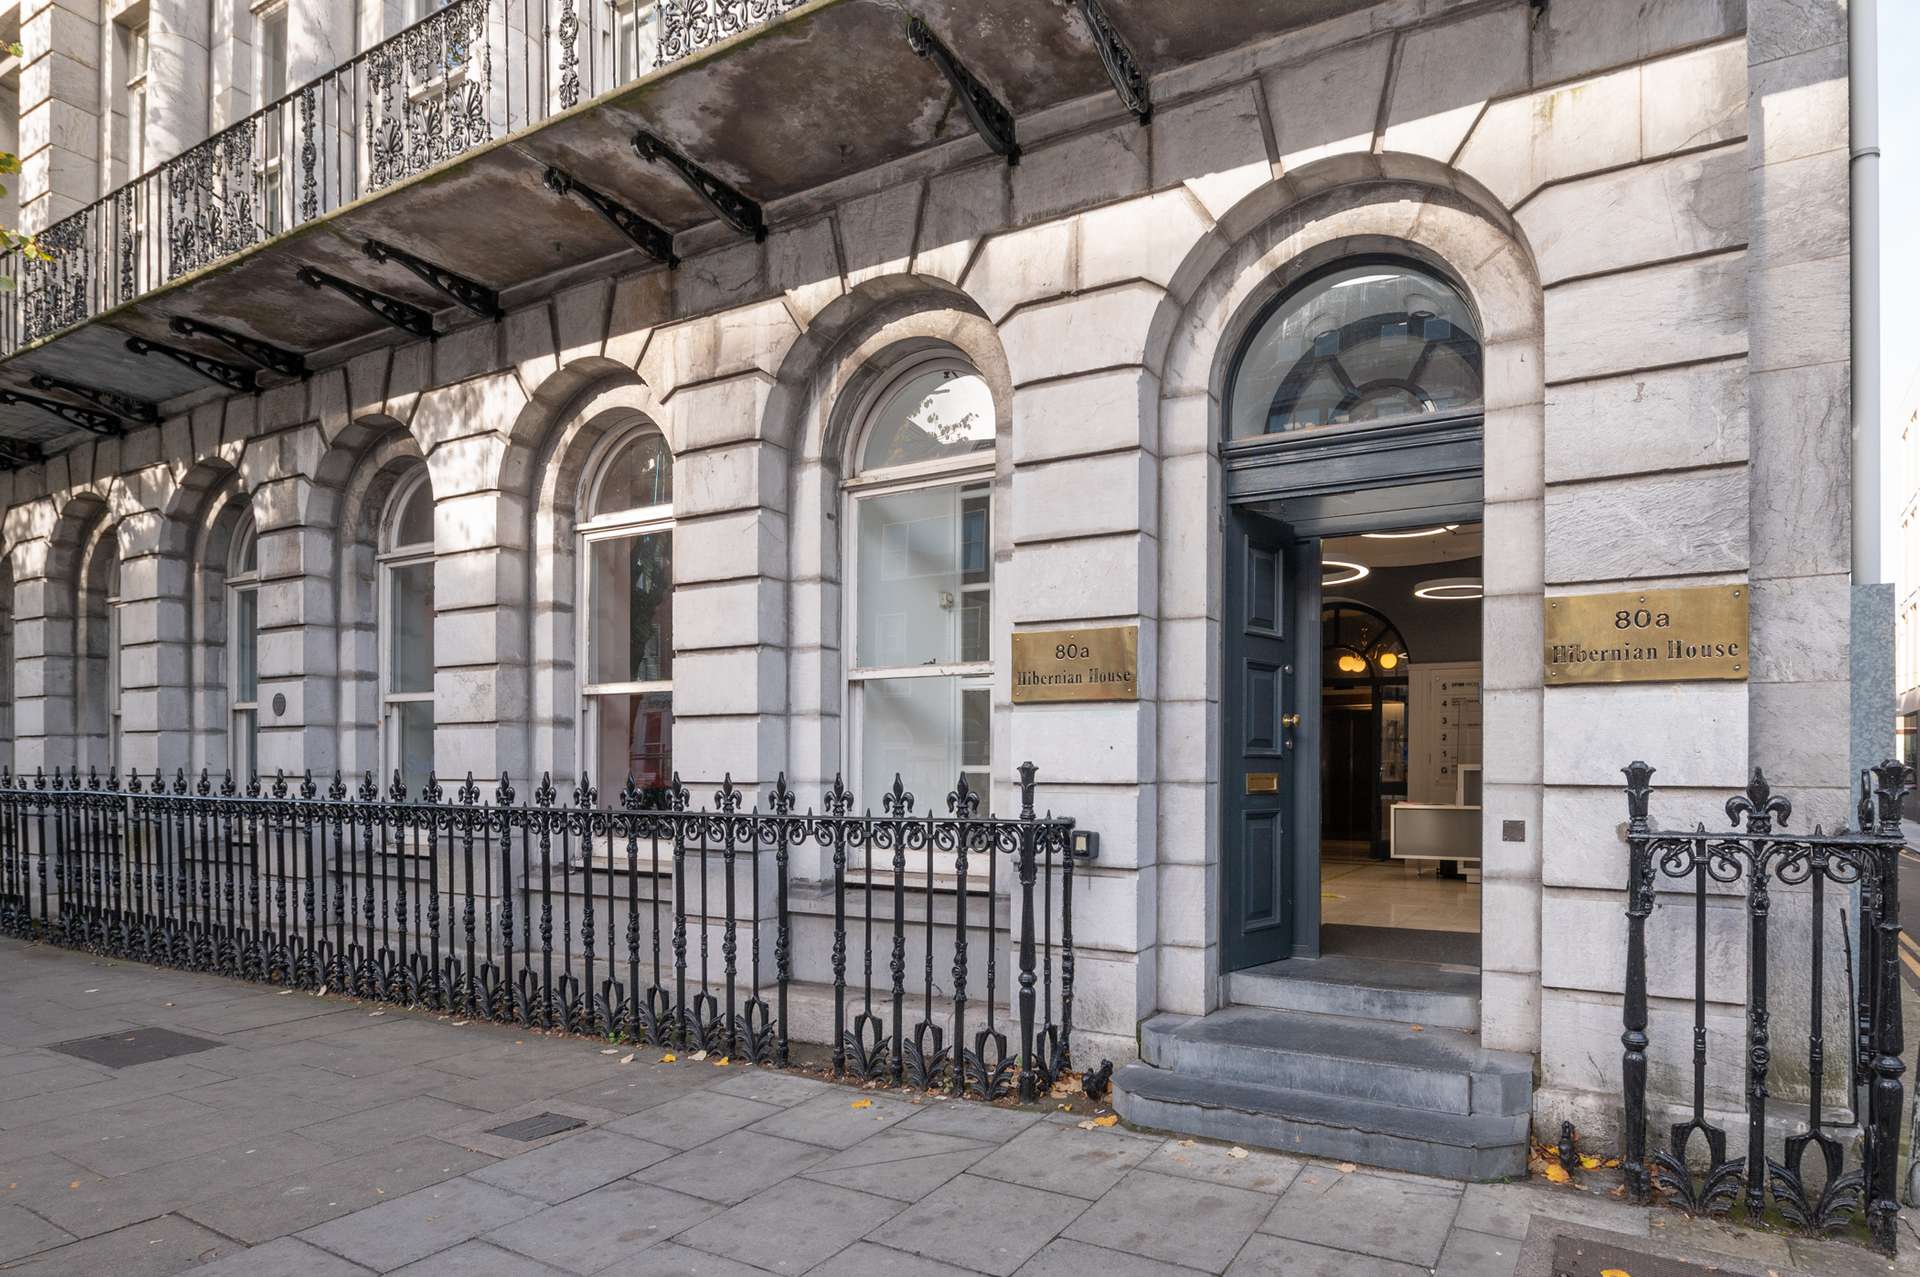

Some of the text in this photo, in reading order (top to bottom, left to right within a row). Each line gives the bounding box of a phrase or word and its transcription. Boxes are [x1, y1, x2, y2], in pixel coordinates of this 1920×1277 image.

[1615, 609, 1670, 629] 80a
[1055, 643, 1090, 660] 80a
[1552, 639, 1739, 663] Hibernian House
[1017, 668, 1131, 686] Hibernian House
